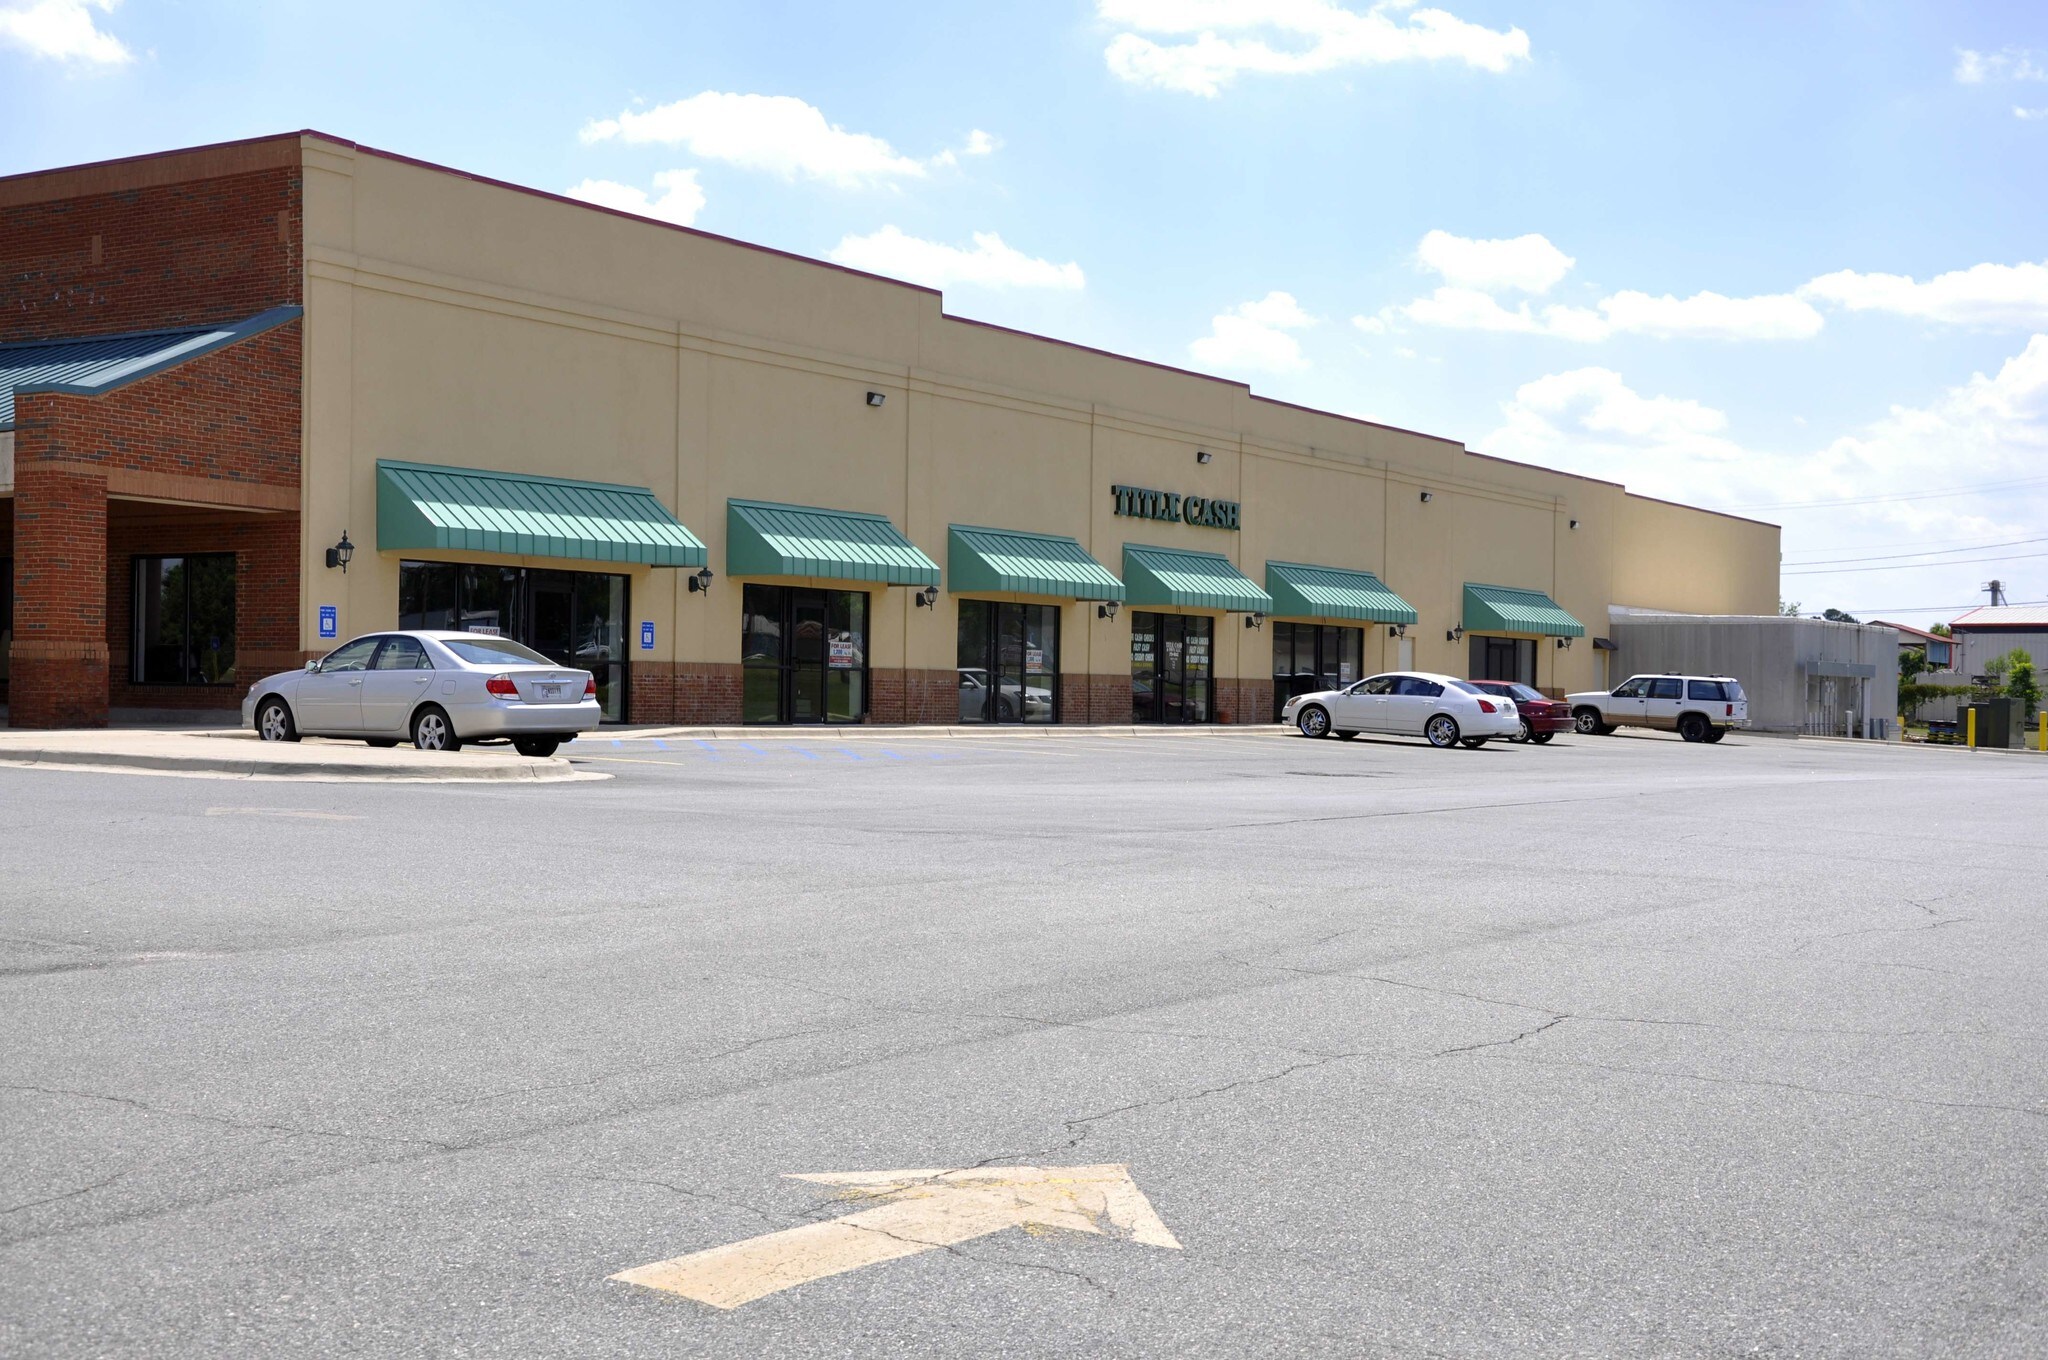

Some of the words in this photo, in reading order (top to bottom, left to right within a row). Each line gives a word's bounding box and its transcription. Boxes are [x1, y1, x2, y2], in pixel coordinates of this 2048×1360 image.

[1112, 485, 1181, 522] TITLE
[1183, 495, 1240, 530] CASH
[1135, 633, 1143, 641] CASH
